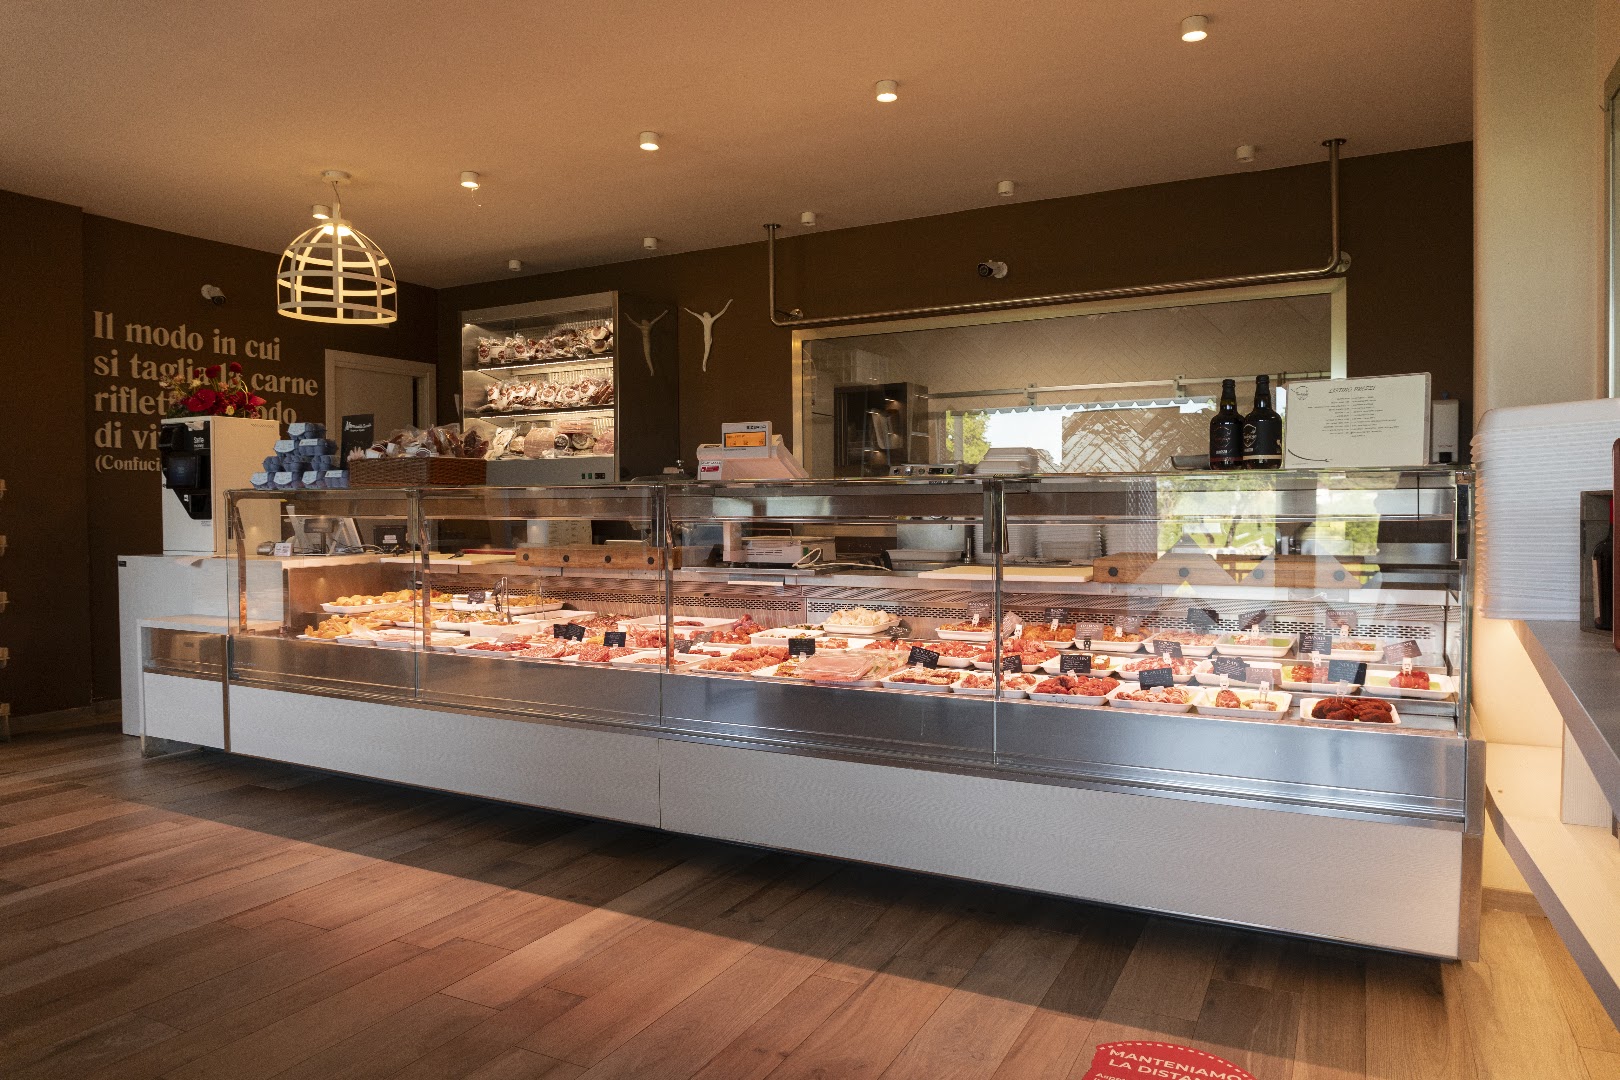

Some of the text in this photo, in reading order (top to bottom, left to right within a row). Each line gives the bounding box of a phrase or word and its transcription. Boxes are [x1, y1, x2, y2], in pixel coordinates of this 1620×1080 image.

[93, 310, 281, 361] Il modo in cui
[93, 349, 119, 377] si
[251, 373, 318, 397] carne
[255, 401, 297, 425] odo
[94, 420, 161, 450] di vi
[95, 454, 161, 473] (Confuci
[1108, 1059, 1203, 1080] LA DISTA
[1109, 1049, 1242, 1080] MANTENIAMO
